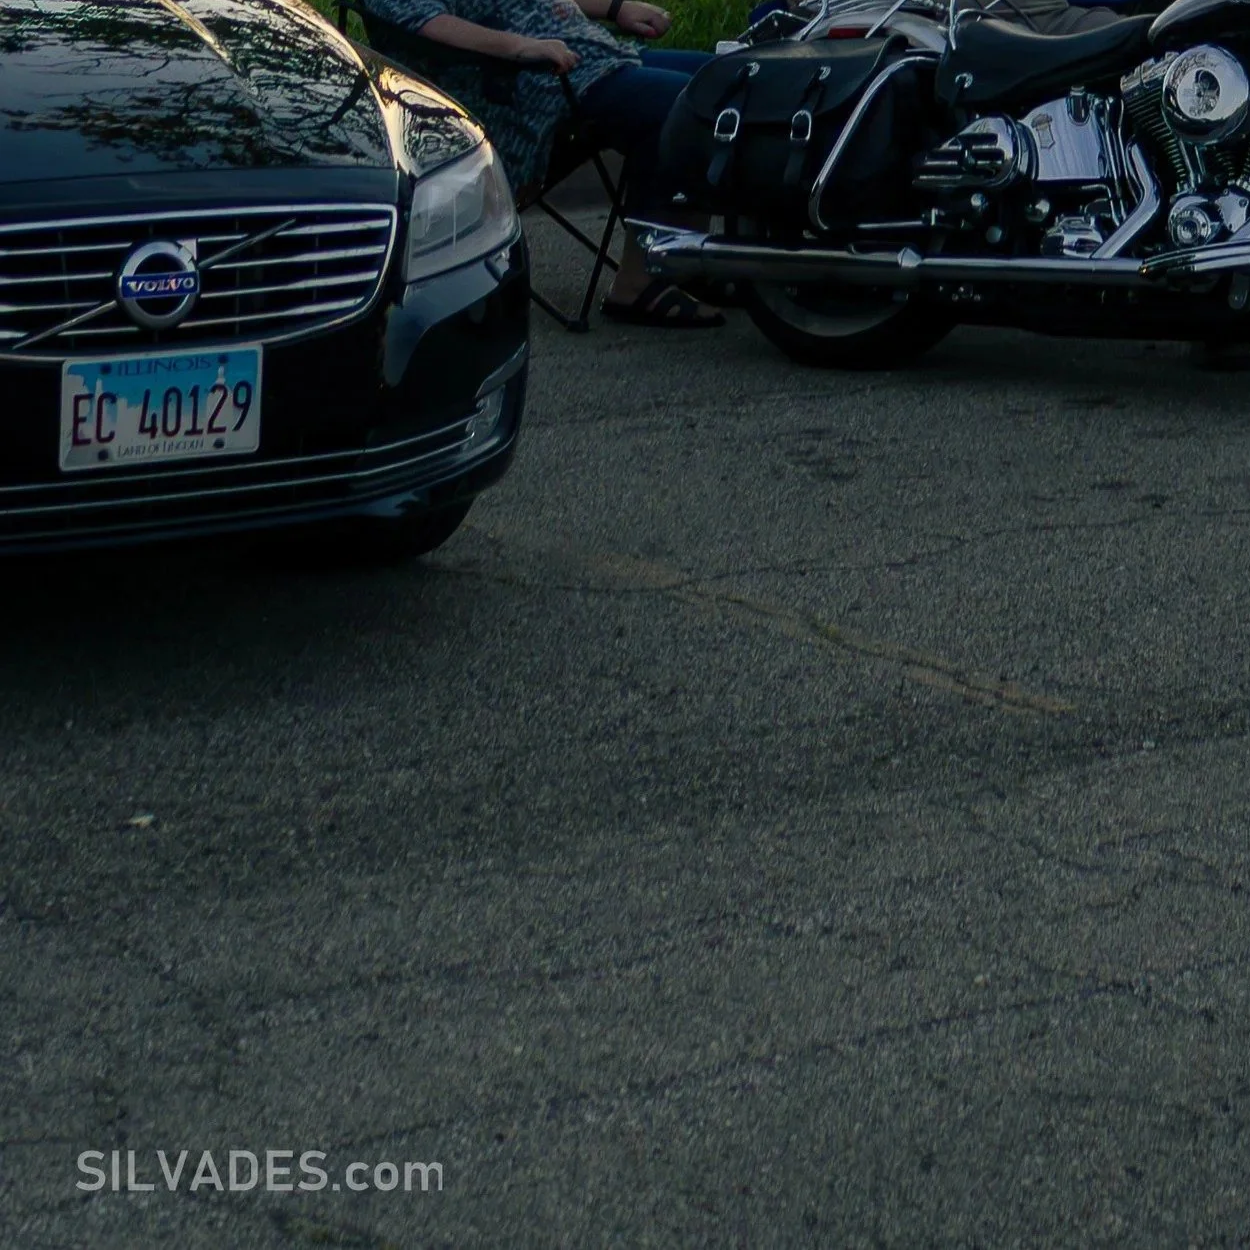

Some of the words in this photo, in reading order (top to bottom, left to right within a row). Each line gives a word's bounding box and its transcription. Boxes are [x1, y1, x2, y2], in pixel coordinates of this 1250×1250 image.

[126, 277, 195, 293] VOLVO
[117, 356, 213, 377] ILLINOIS
[72, 392, 117, 447] EC
[138, 380, 253, 440] 40129
